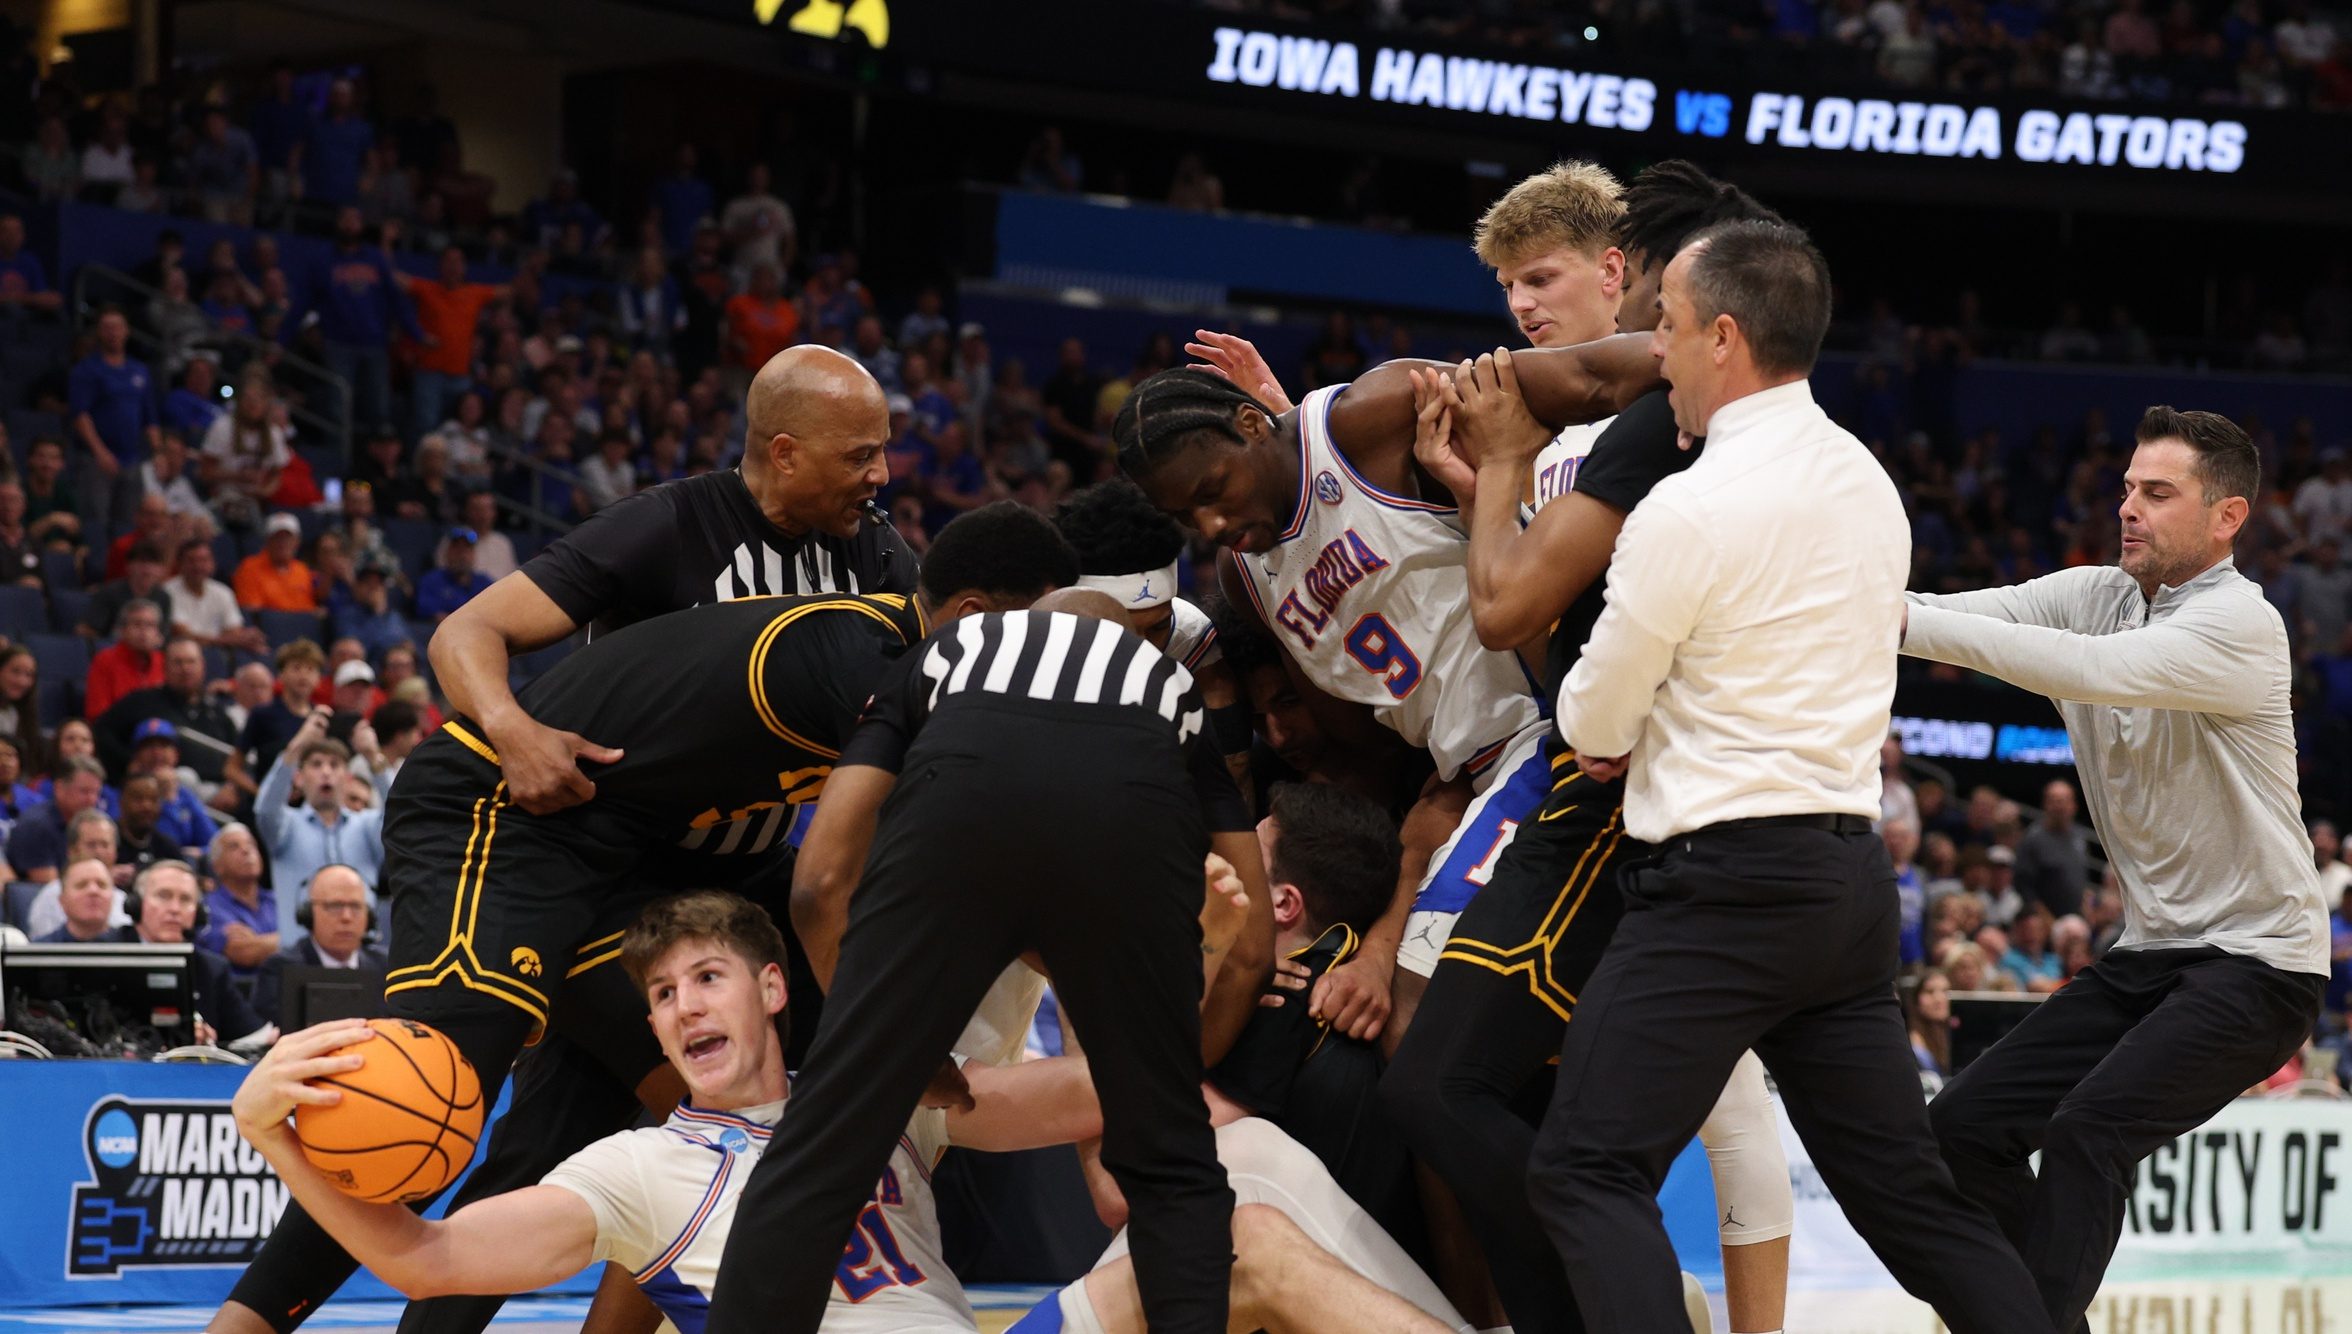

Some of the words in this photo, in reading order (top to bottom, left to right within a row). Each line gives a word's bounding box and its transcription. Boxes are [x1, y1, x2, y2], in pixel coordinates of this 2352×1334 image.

[1206, 27, 1360, 97] IOWA
[1370, 47, 1658, 133] HAWKEYES
[1674, 89, 1732, 138] VS
[1745, 92, 2002, 160] FLORIDA
[2014, 109, 2248, 174] GATORS
[1275, 528, 1391, 651] FLORIDA
[1344, 612, 1422, 700] 9
[139, 1112, 276, 1175] MARC
[2284, 1131, 2340, 1231] OF
[160, 1177, 291, 1240] MADN
[834, 1203, 928, 1304] 21
